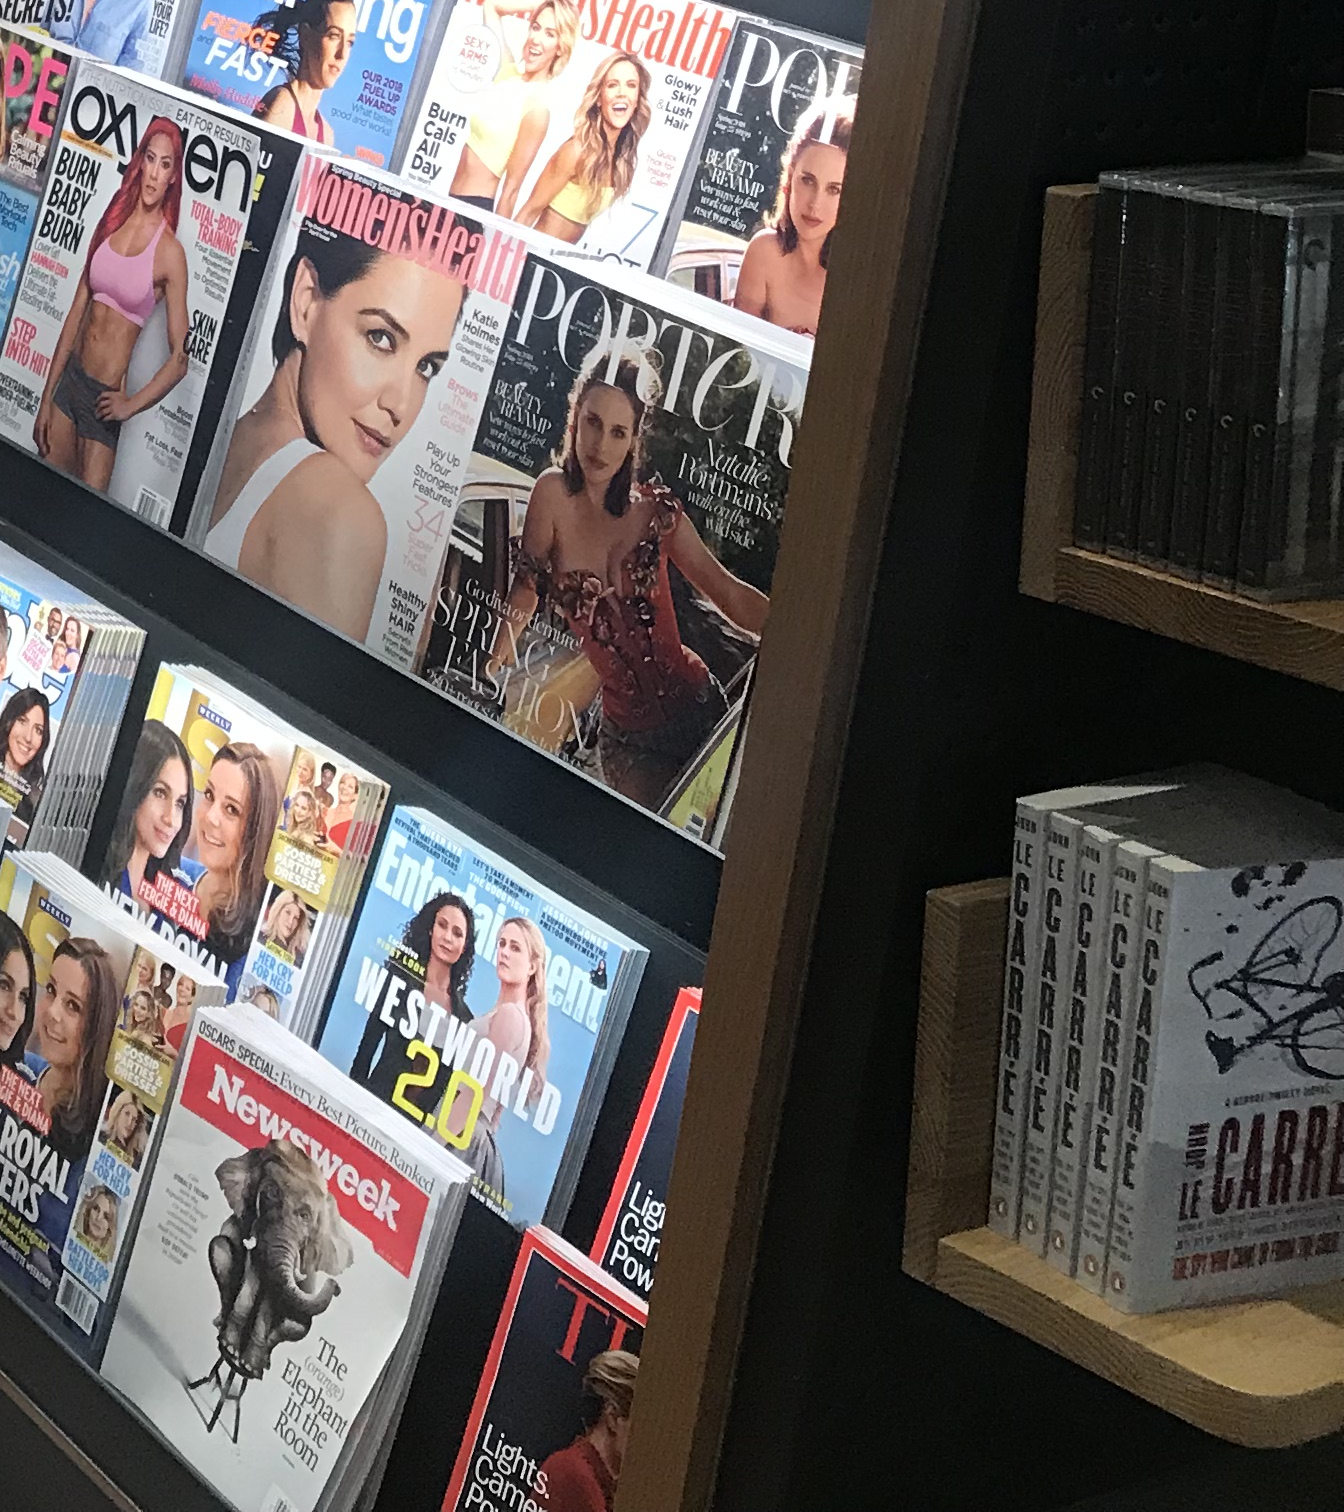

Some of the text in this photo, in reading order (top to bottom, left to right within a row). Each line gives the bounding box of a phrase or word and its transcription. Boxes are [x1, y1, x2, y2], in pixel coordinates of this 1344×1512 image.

[204, 38, 290, 88] FAST
[423, 119, 457, 145] Cals
[427, 101, 467, 130] Burn
[411, 153, 442, 181] Day
[415, 138, 441, 159] All
[46, 180, 91, 227] BABY,
[196, 221, 238, 257] TRAINING
[462, 318, 501, 347] Holmes
[472, 308, 500, 331] Katie
[413, 463, 460, 497] Strongest
[678, 450, 777, 522] Portman's
[388, 578, 429, 612] Healthy
[355, 957, 563, 1137] WESTWORLD
[391, 1039, 484, 1151] 2.0
[206, 1063, 402, 1233] Newsweek
[316, 1095, 437, 1194] Best Picture, Ranked
[280, 1358, 349, 1440] Elephant
[272, 1410, 321, 1474] Room
[480, 1422, 552, 1500] Lights.
